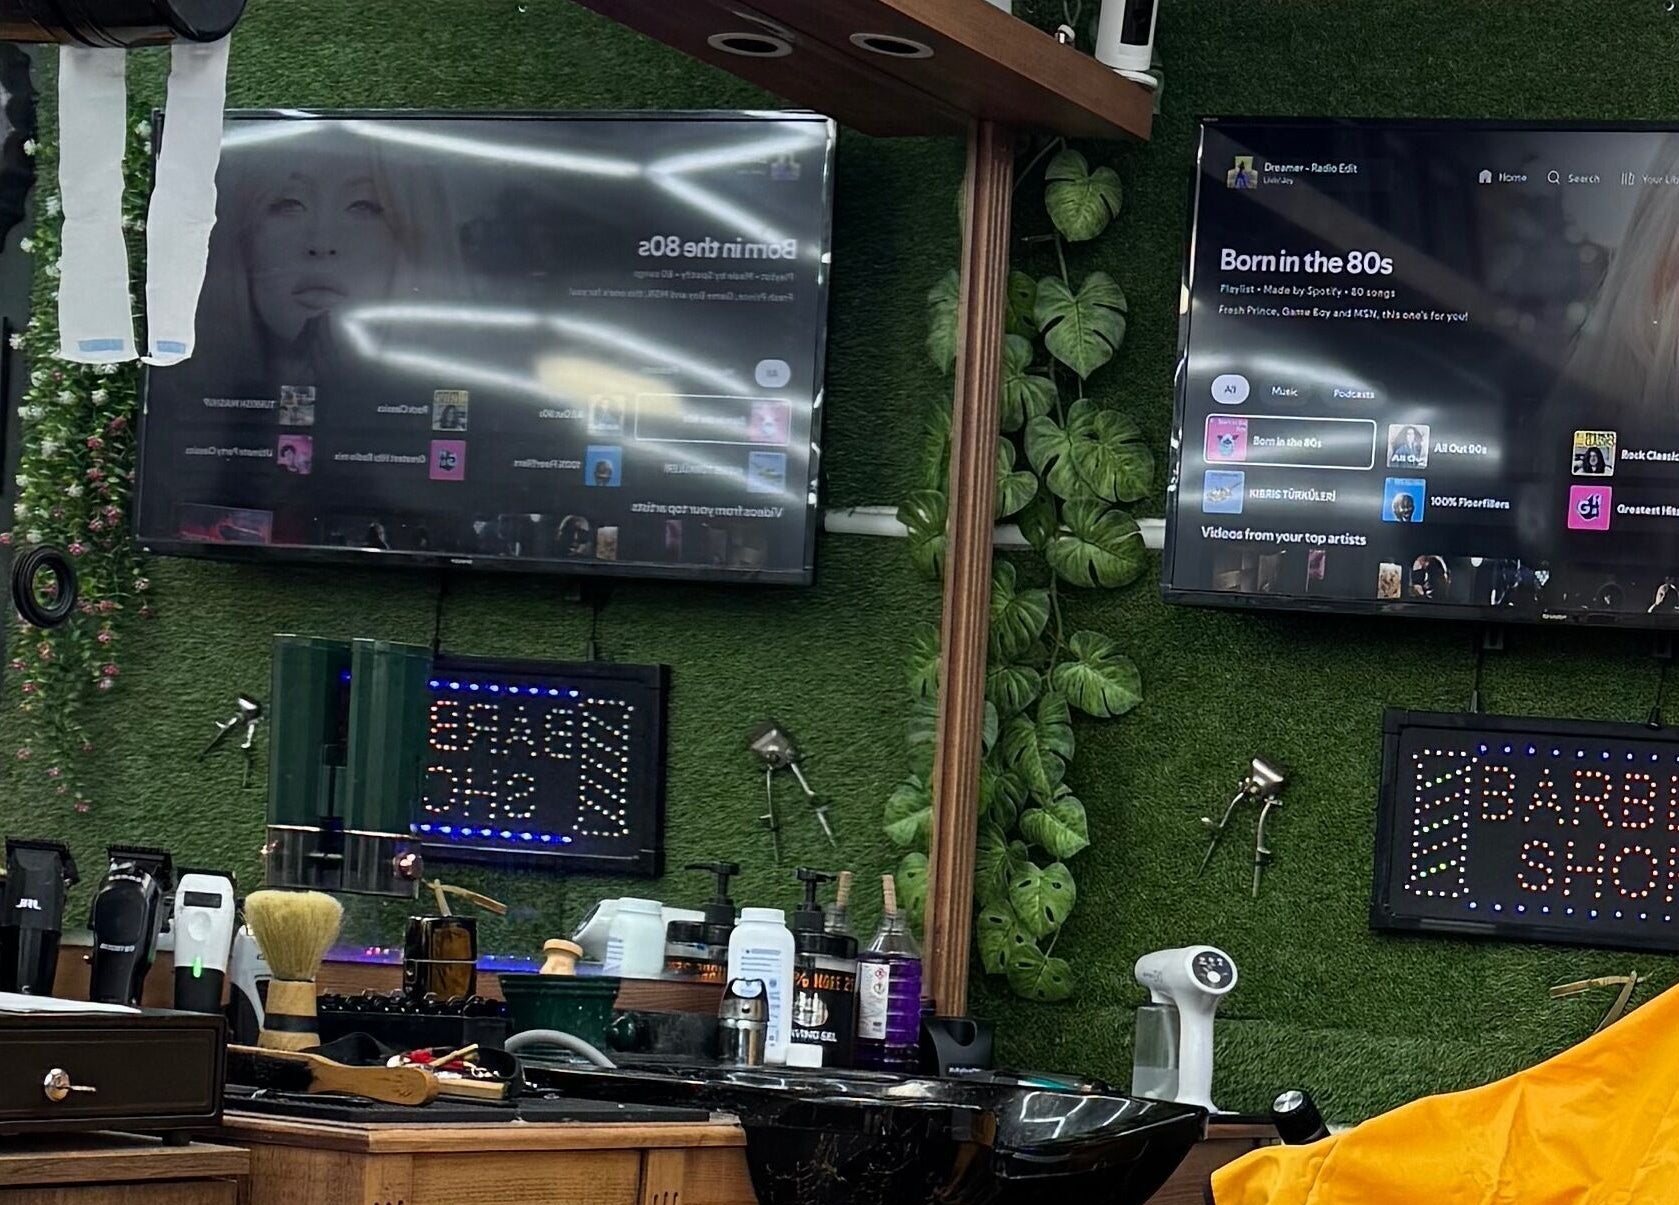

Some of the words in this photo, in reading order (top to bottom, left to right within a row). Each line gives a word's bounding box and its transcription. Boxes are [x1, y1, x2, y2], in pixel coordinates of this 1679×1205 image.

[1311, 163, 1337, 173] Radio
[1339, 163, 1357, 174] Edit
[1499, 173, 1528, 183] Home
[1567, 174, 1600, 184] Search
[1220, 248, 1275, 271] Born
[1279, 249, 1299, 272] in
[1303, 250, 1343, 274] the
[1346, 251, 1393, 275] 80s
[1220, 284, 1254, 295] Playlist
[1263, 286, 1291, 295] Made
[1292, 286, 1305, 297] by
[1306, 286, 1342, 298] Spotify
[1366, 288, 1396, 298] songs
[1218, 305, 1245, 315] Fresh
[1333, 308, 1351, 318] and
[1382, 309, 1400, 320] this
[1430, 311, 1444, 321] for
[1271, 387, 1298, 397] Music
[1333, 388, 1375, 400] Podcasts
[1253, 436, 1275, 446] Born
[1276, 437, 1285, 446] in
[1287, 437, 1302, 447] the
[1621, 449, 1645, 460] Rock
[1431, 496, 1457, 507] 100%
[1617, 504, 1660, 515] Greatest
[1201, 526, 1243, 540] Videos
[1244, 528, 1274, 541] from
[1275, 531, 1302, 544] your
[1305, 532, 1327, 545] top
[1327, 533, 1367, 546] artists
